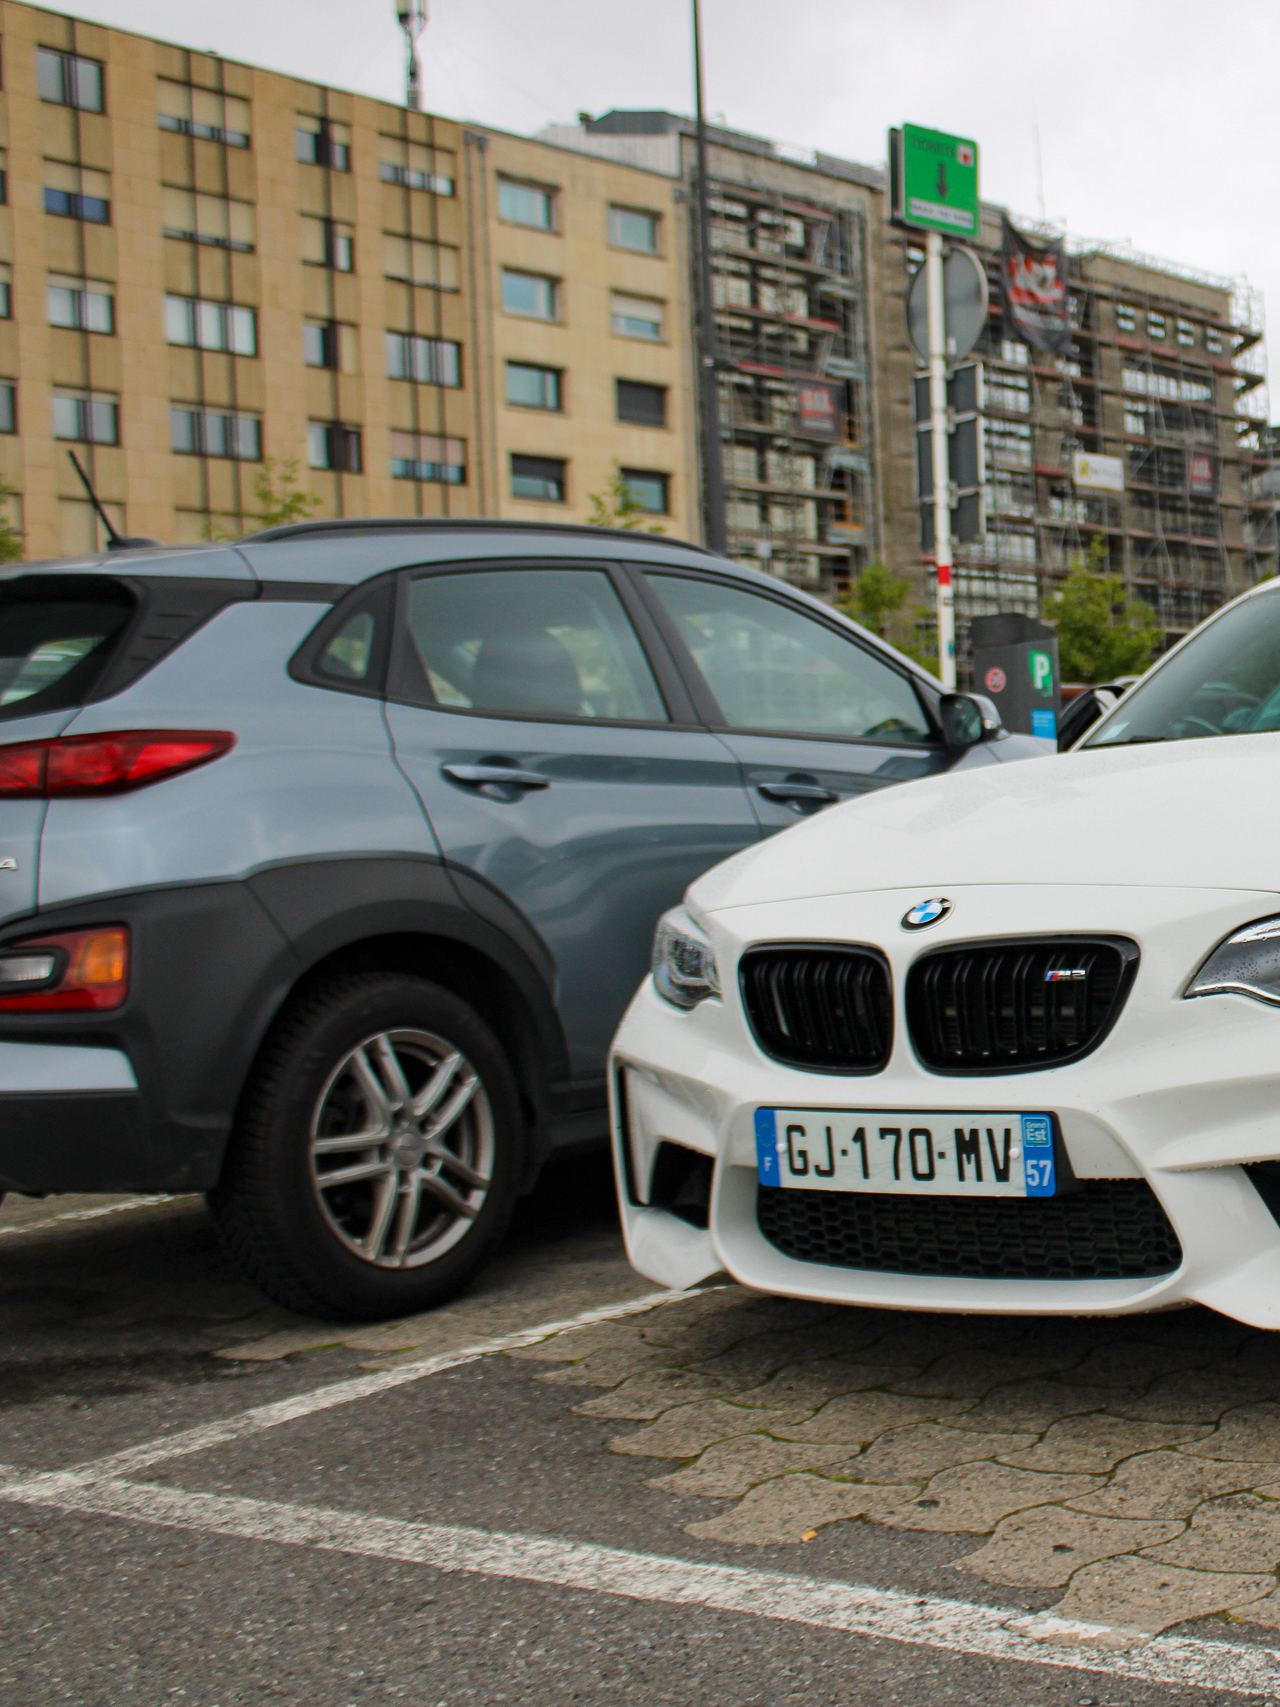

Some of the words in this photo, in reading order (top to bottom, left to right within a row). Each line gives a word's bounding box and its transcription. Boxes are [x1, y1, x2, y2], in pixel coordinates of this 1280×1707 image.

[1034, 654, 1050, 690] P
[1026, 1128, 1047, 1141] Est
[764, 1157, 772, 1171] F
[786, 1124, 1012, 1183] GJ-170-MV
[1026, 1160, 1052, 1187] 57
